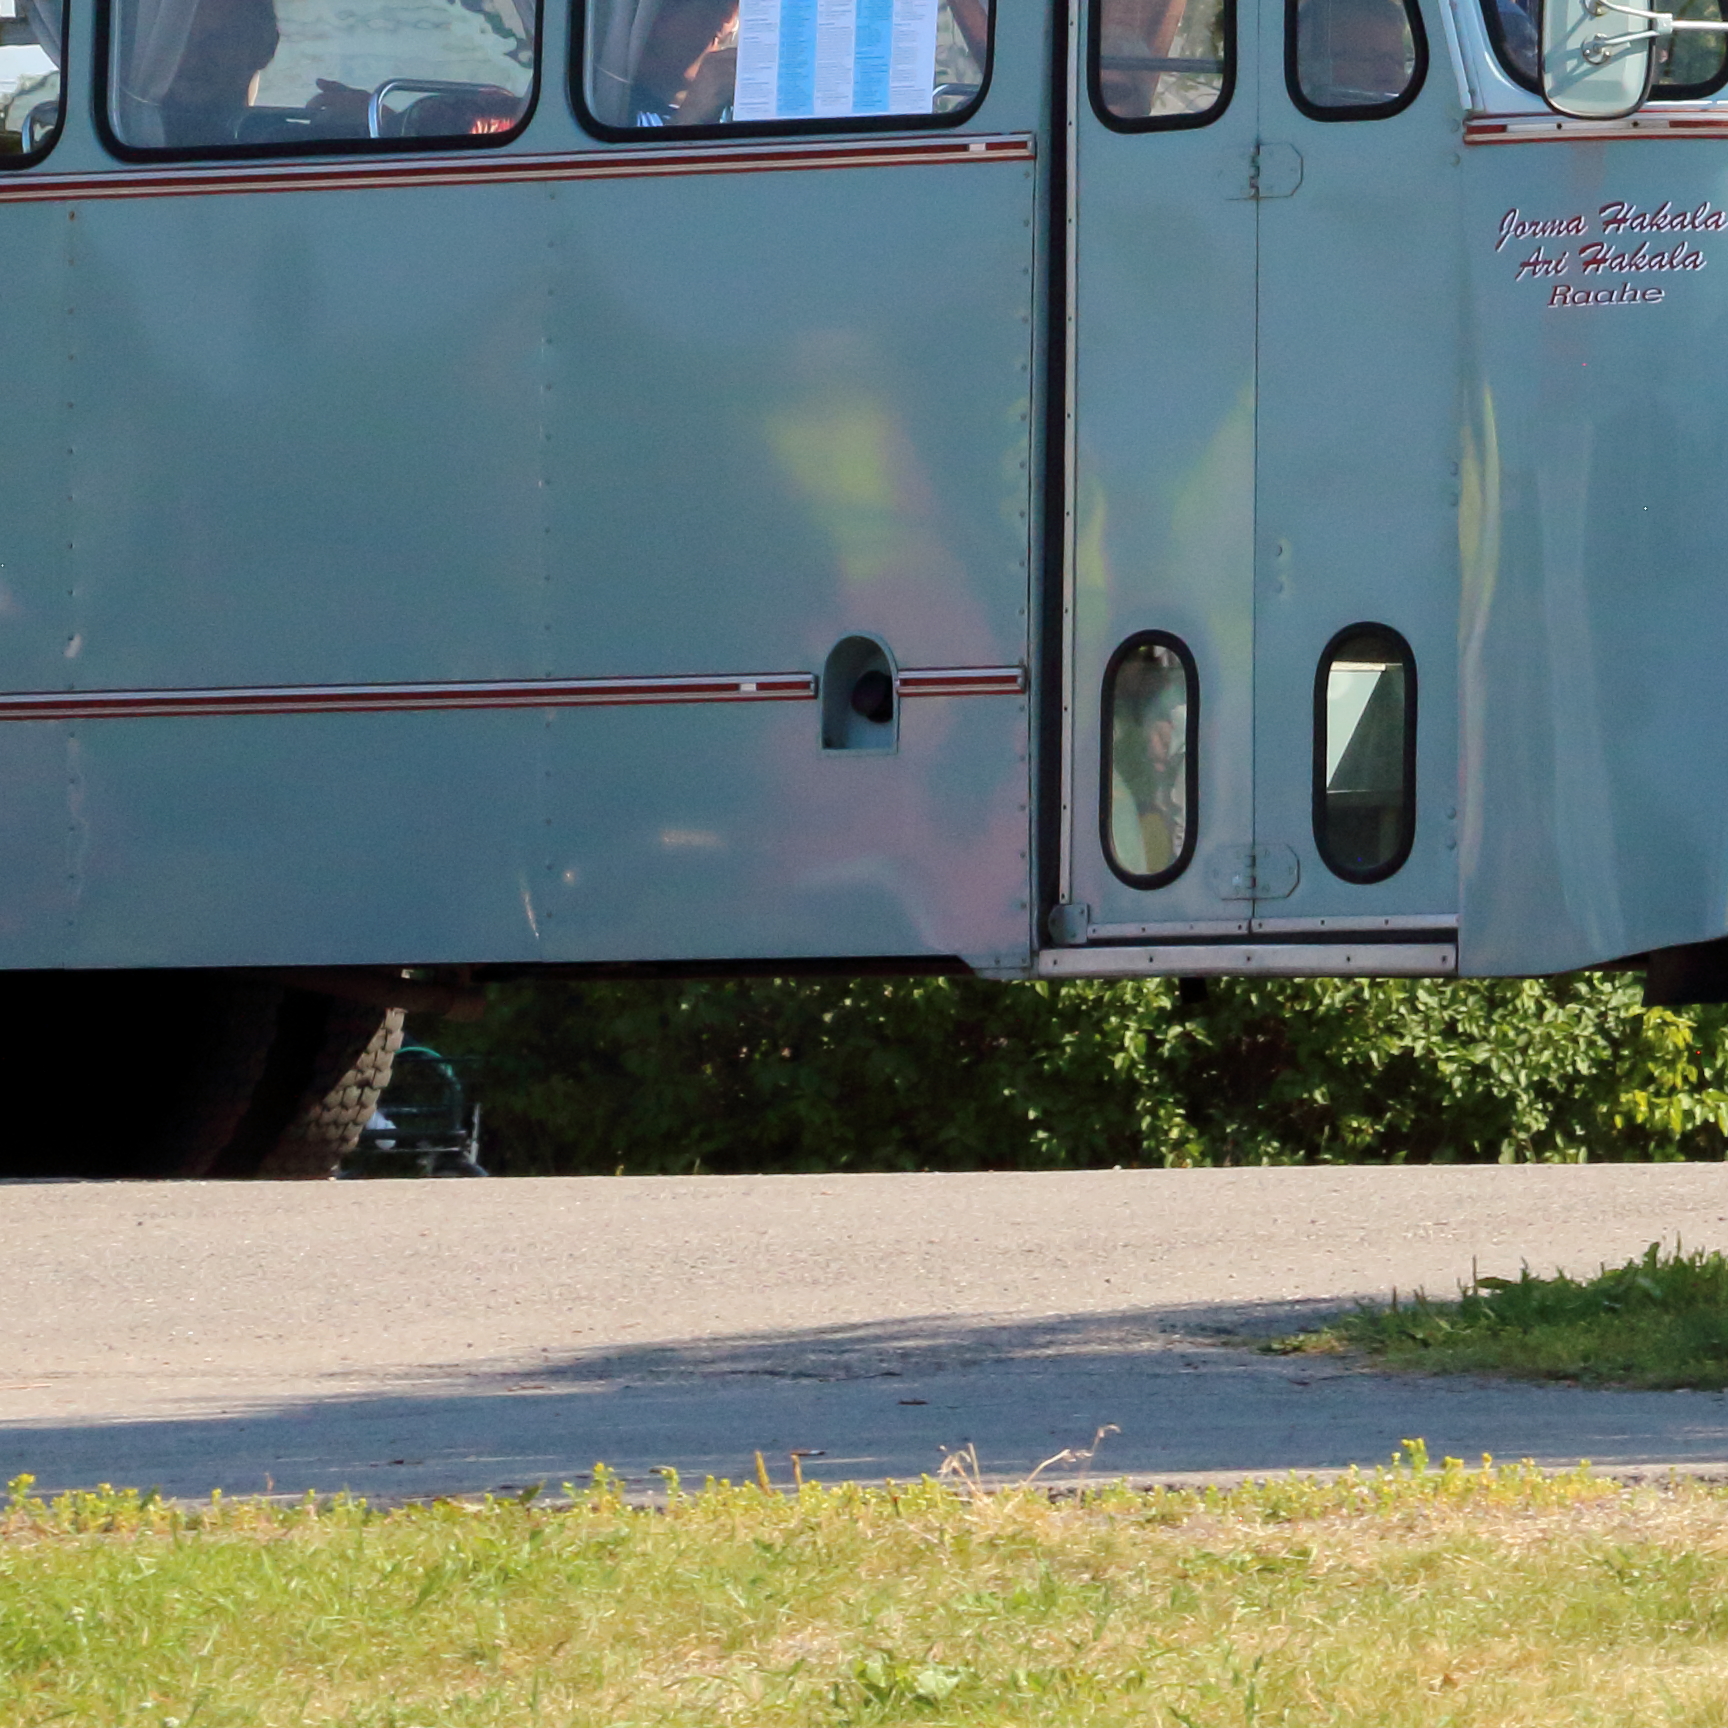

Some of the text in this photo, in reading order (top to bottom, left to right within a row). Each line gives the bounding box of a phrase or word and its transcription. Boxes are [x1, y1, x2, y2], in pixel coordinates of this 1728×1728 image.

[1495, 208, 1588, 252] Jorma
[1516, 241, 1708, 281] Ari Hakala
[1548, 282, 1665, 308] Raahe
